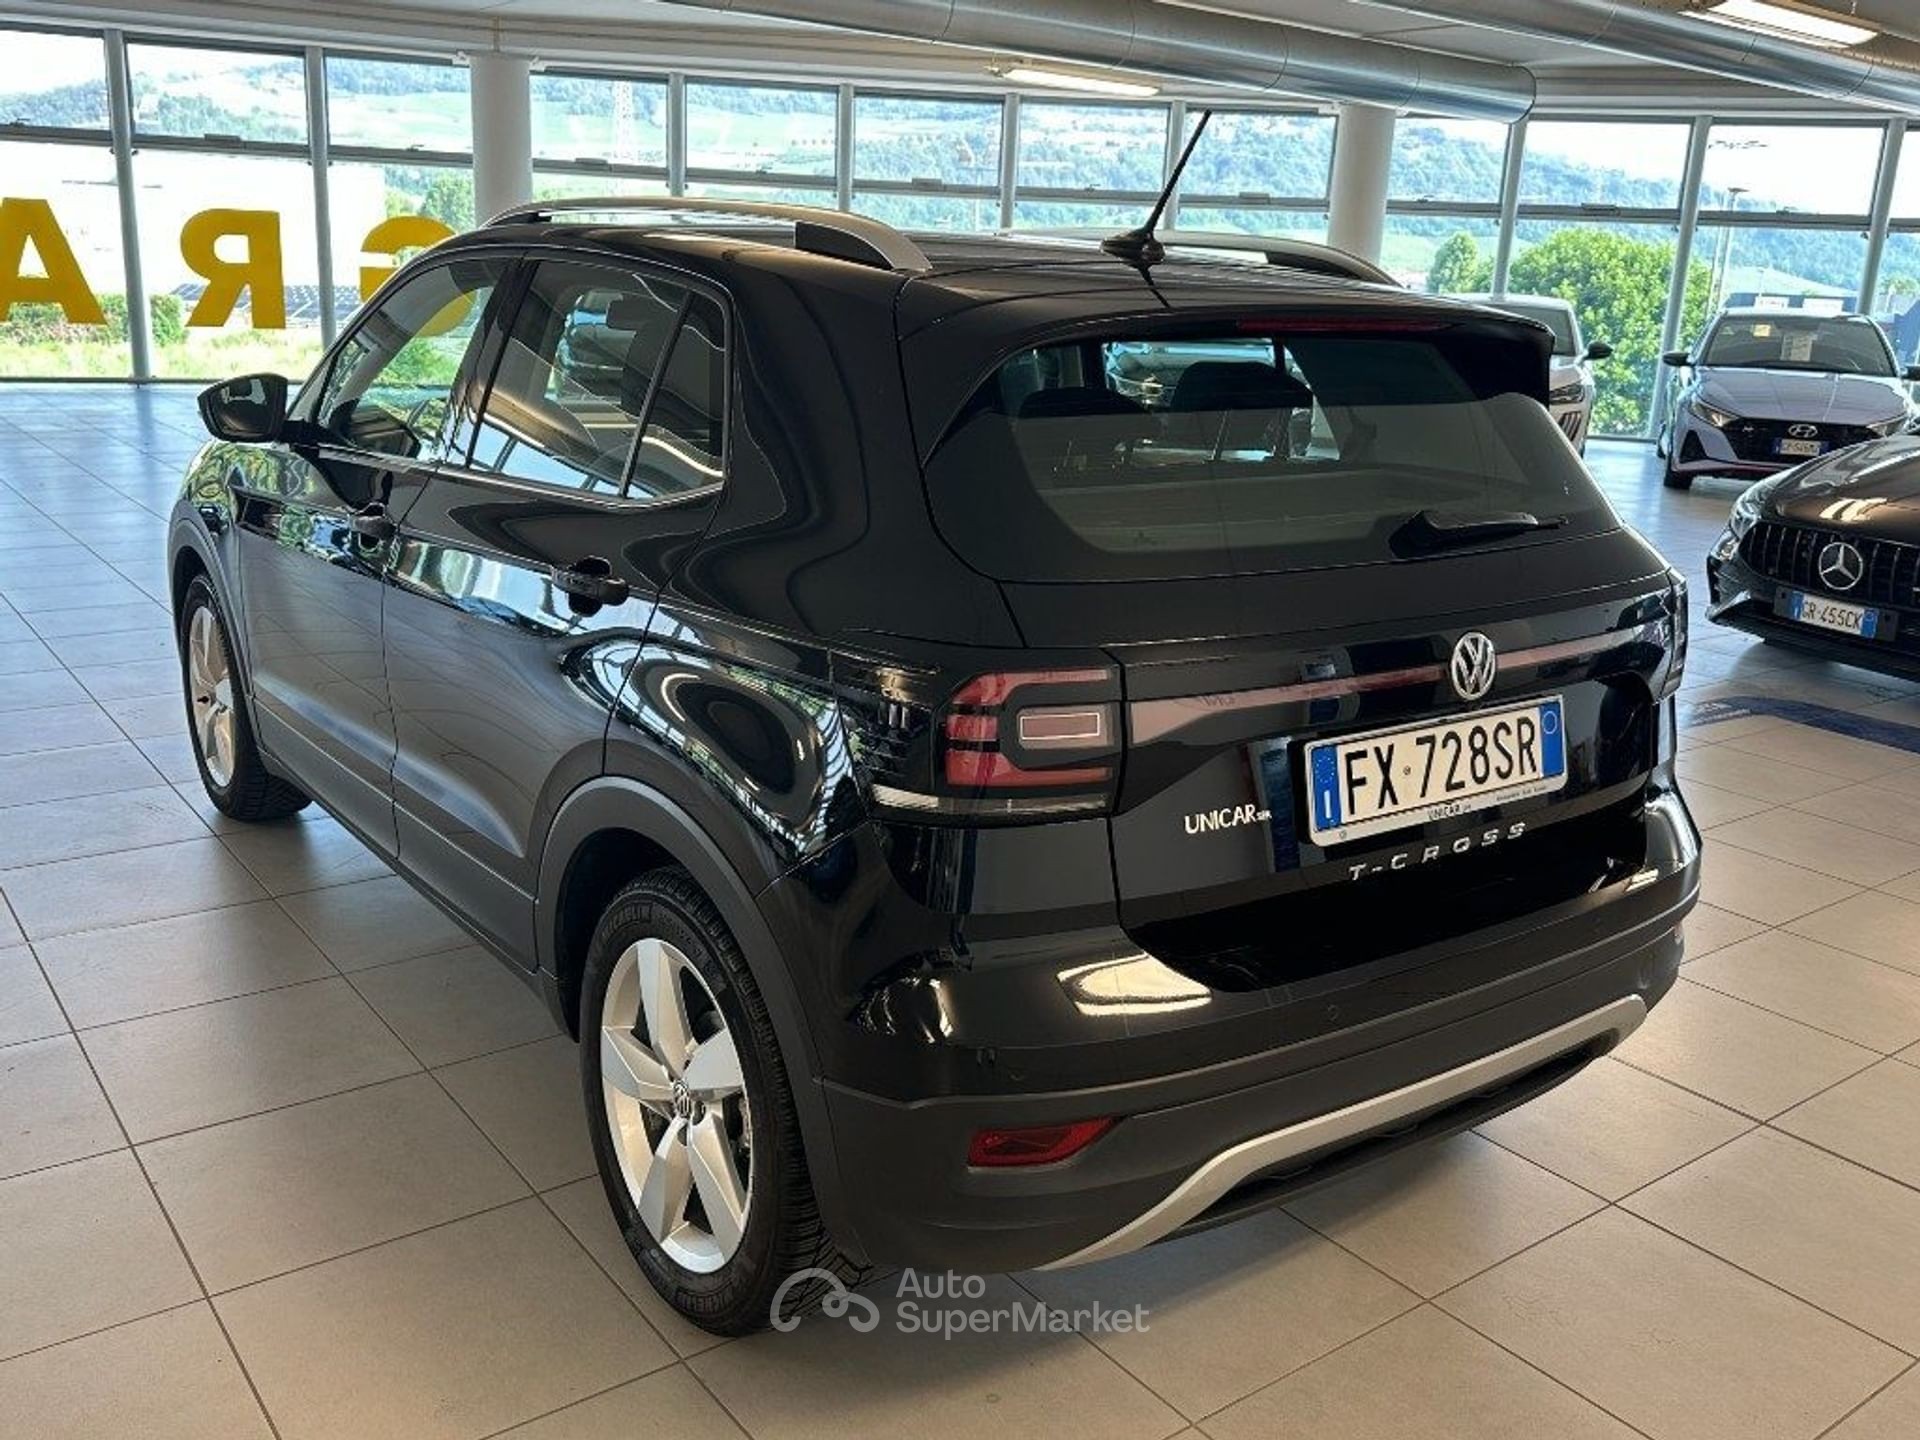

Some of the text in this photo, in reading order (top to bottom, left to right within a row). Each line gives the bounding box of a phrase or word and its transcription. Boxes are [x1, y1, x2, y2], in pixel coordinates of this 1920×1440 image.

[1344, 716, 1538, 816] FX 728SR
[1184, 803, 1257, 835] UNICAR
[1349, 821, 1527, 881] T-CROSS
